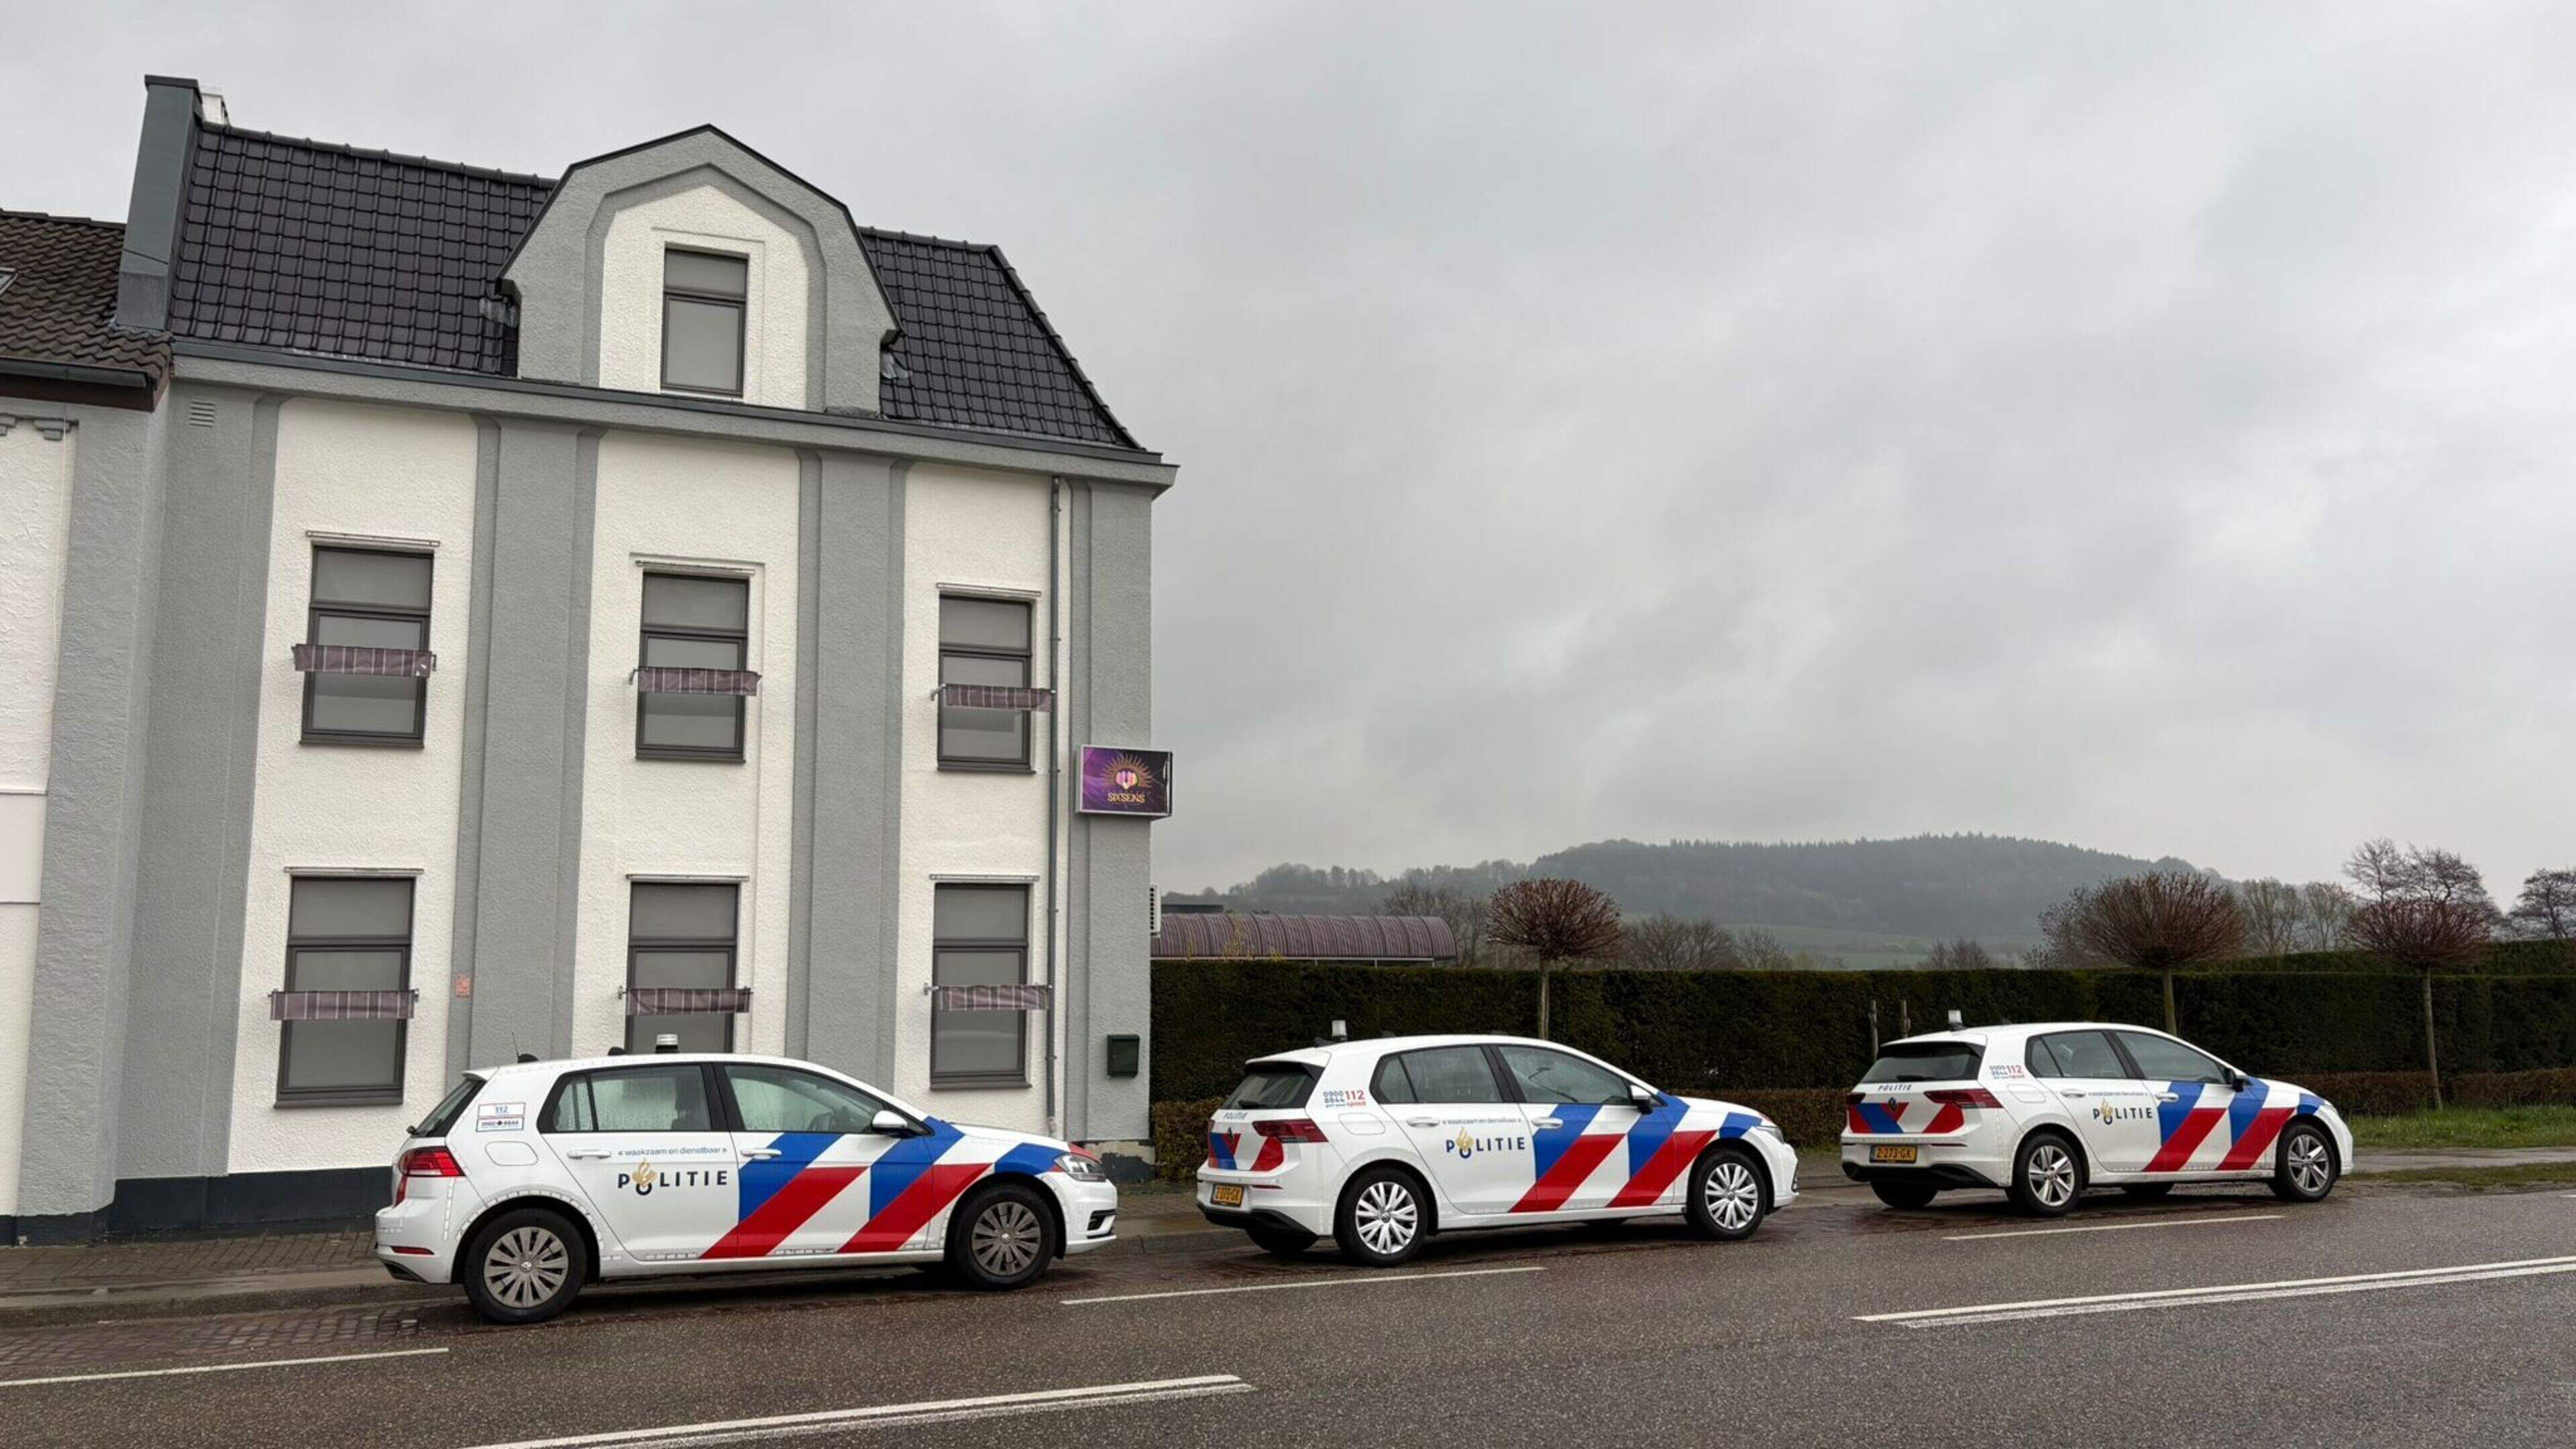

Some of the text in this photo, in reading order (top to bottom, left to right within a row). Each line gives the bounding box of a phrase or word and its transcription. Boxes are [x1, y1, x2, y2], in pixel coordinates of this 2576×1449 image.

[1345, 1089, 1365, 1099] 112
[495, 1106, 508, 1114] 112
[2093, 1108, 2153, 1125] POLITIE
[625, 1148, 667, 1156] waakzaam
[680, 1146, 720, 1155] dienstbaar
[1446, 1137, 1525, 1159] POLITIE
[618, 1171, 727, 1195] POLITIE
